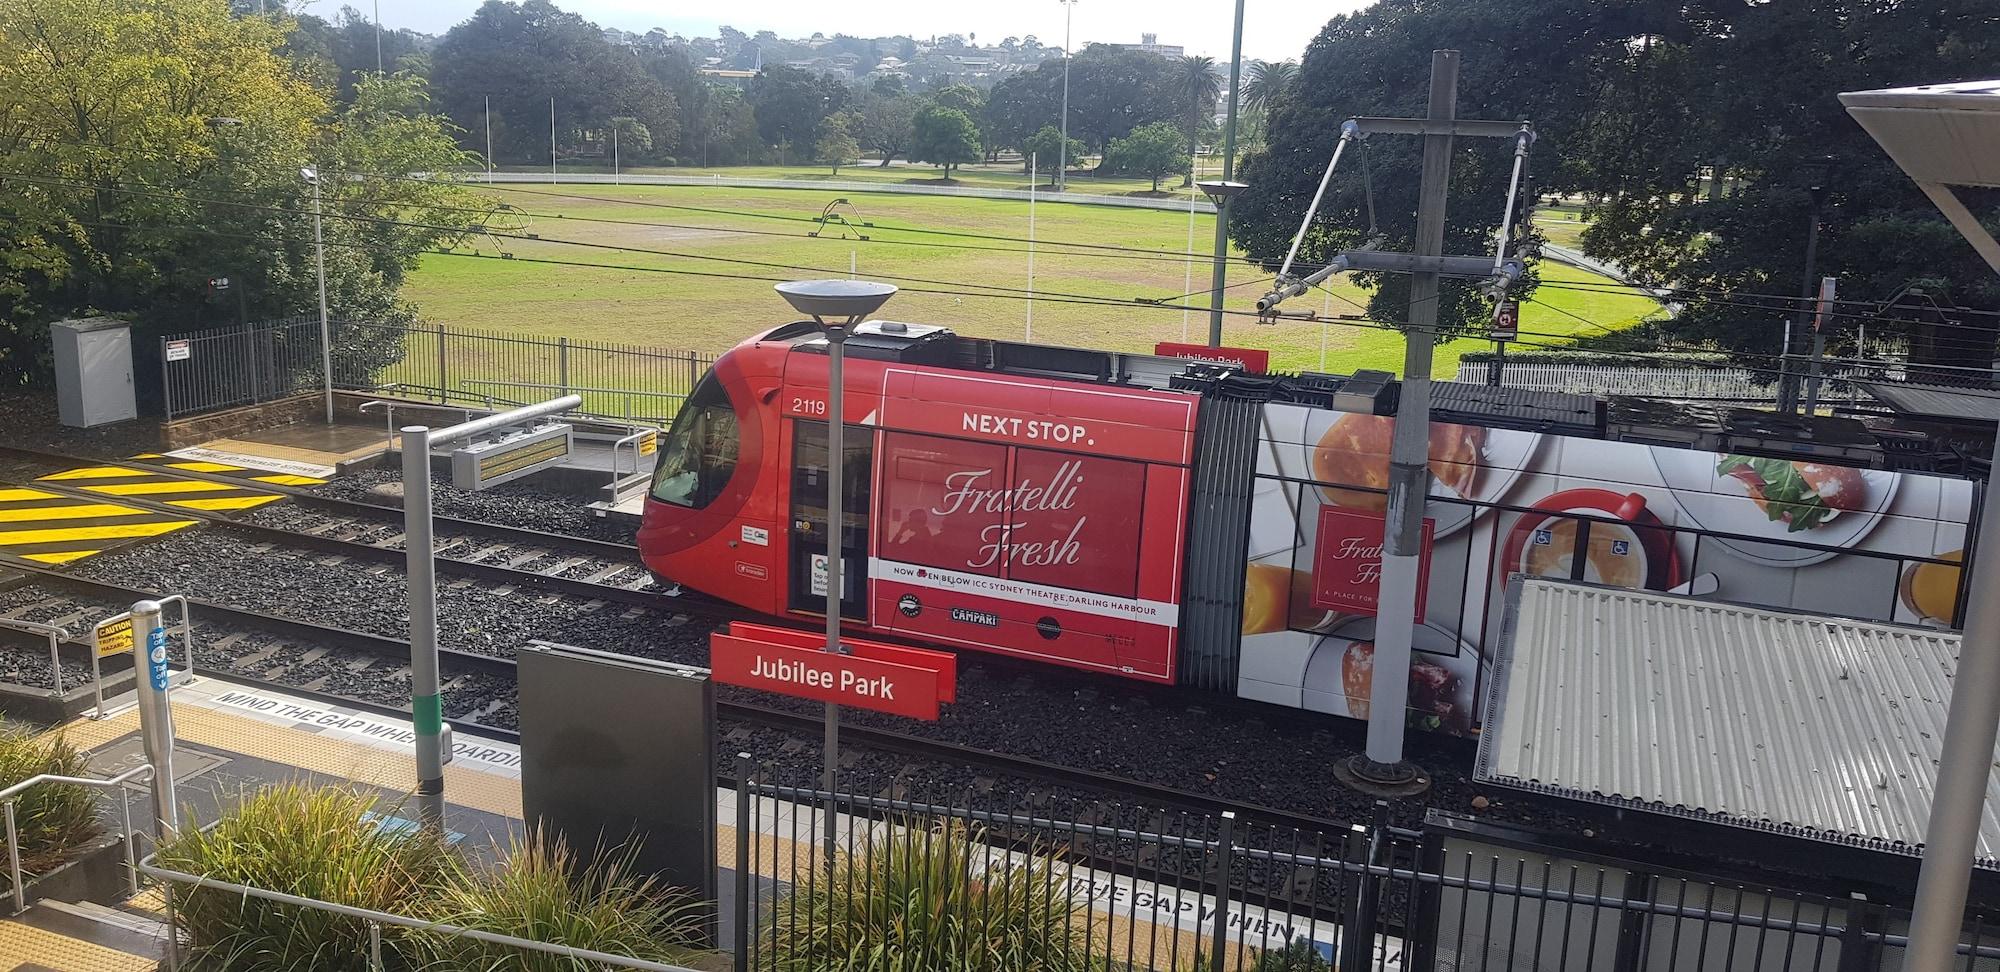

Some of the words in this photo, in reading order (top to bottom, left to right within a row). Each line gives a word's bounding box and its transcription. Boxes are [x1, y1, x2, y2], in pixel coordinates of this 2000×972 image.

[793, 398, 825, 415] 2119
[962, 412, 1022, 437] NEXT
[1027, 420, 1095, 446] STOP.
[931, 460, 1084, 516] Fratelli
[967, 516, 1086, 568] Fresh
[1333, 537, 1384, 559] Frat
[894, 567, 914, 576] NOW
[941, 574, 970, 585] BELOW
[973, 580, 987, 588] ICC
[989, 583, 1024, 594] SYDNEY
[1069, 595, 1108, 608] DARLING
[1111, 602, 1157, 615] HARBOUR
[1333, 591, 1355, 600] PLACE
[99, 619, 132, 637] CAUTION
[952, 609, 996, 626] CAMPARI
[101, 641, 124, 652] HAZARD
[151, 631, 164, 640] Tap
[750, 655, 834, 689] Jubilee
[840, 669, 894, 700] Park
[218, 692, 277, 710] MIND
[275, 704, 322, 721] THE
[315, 714, 363, 730] GAP
[452, 743, 521, 767] OARDI
